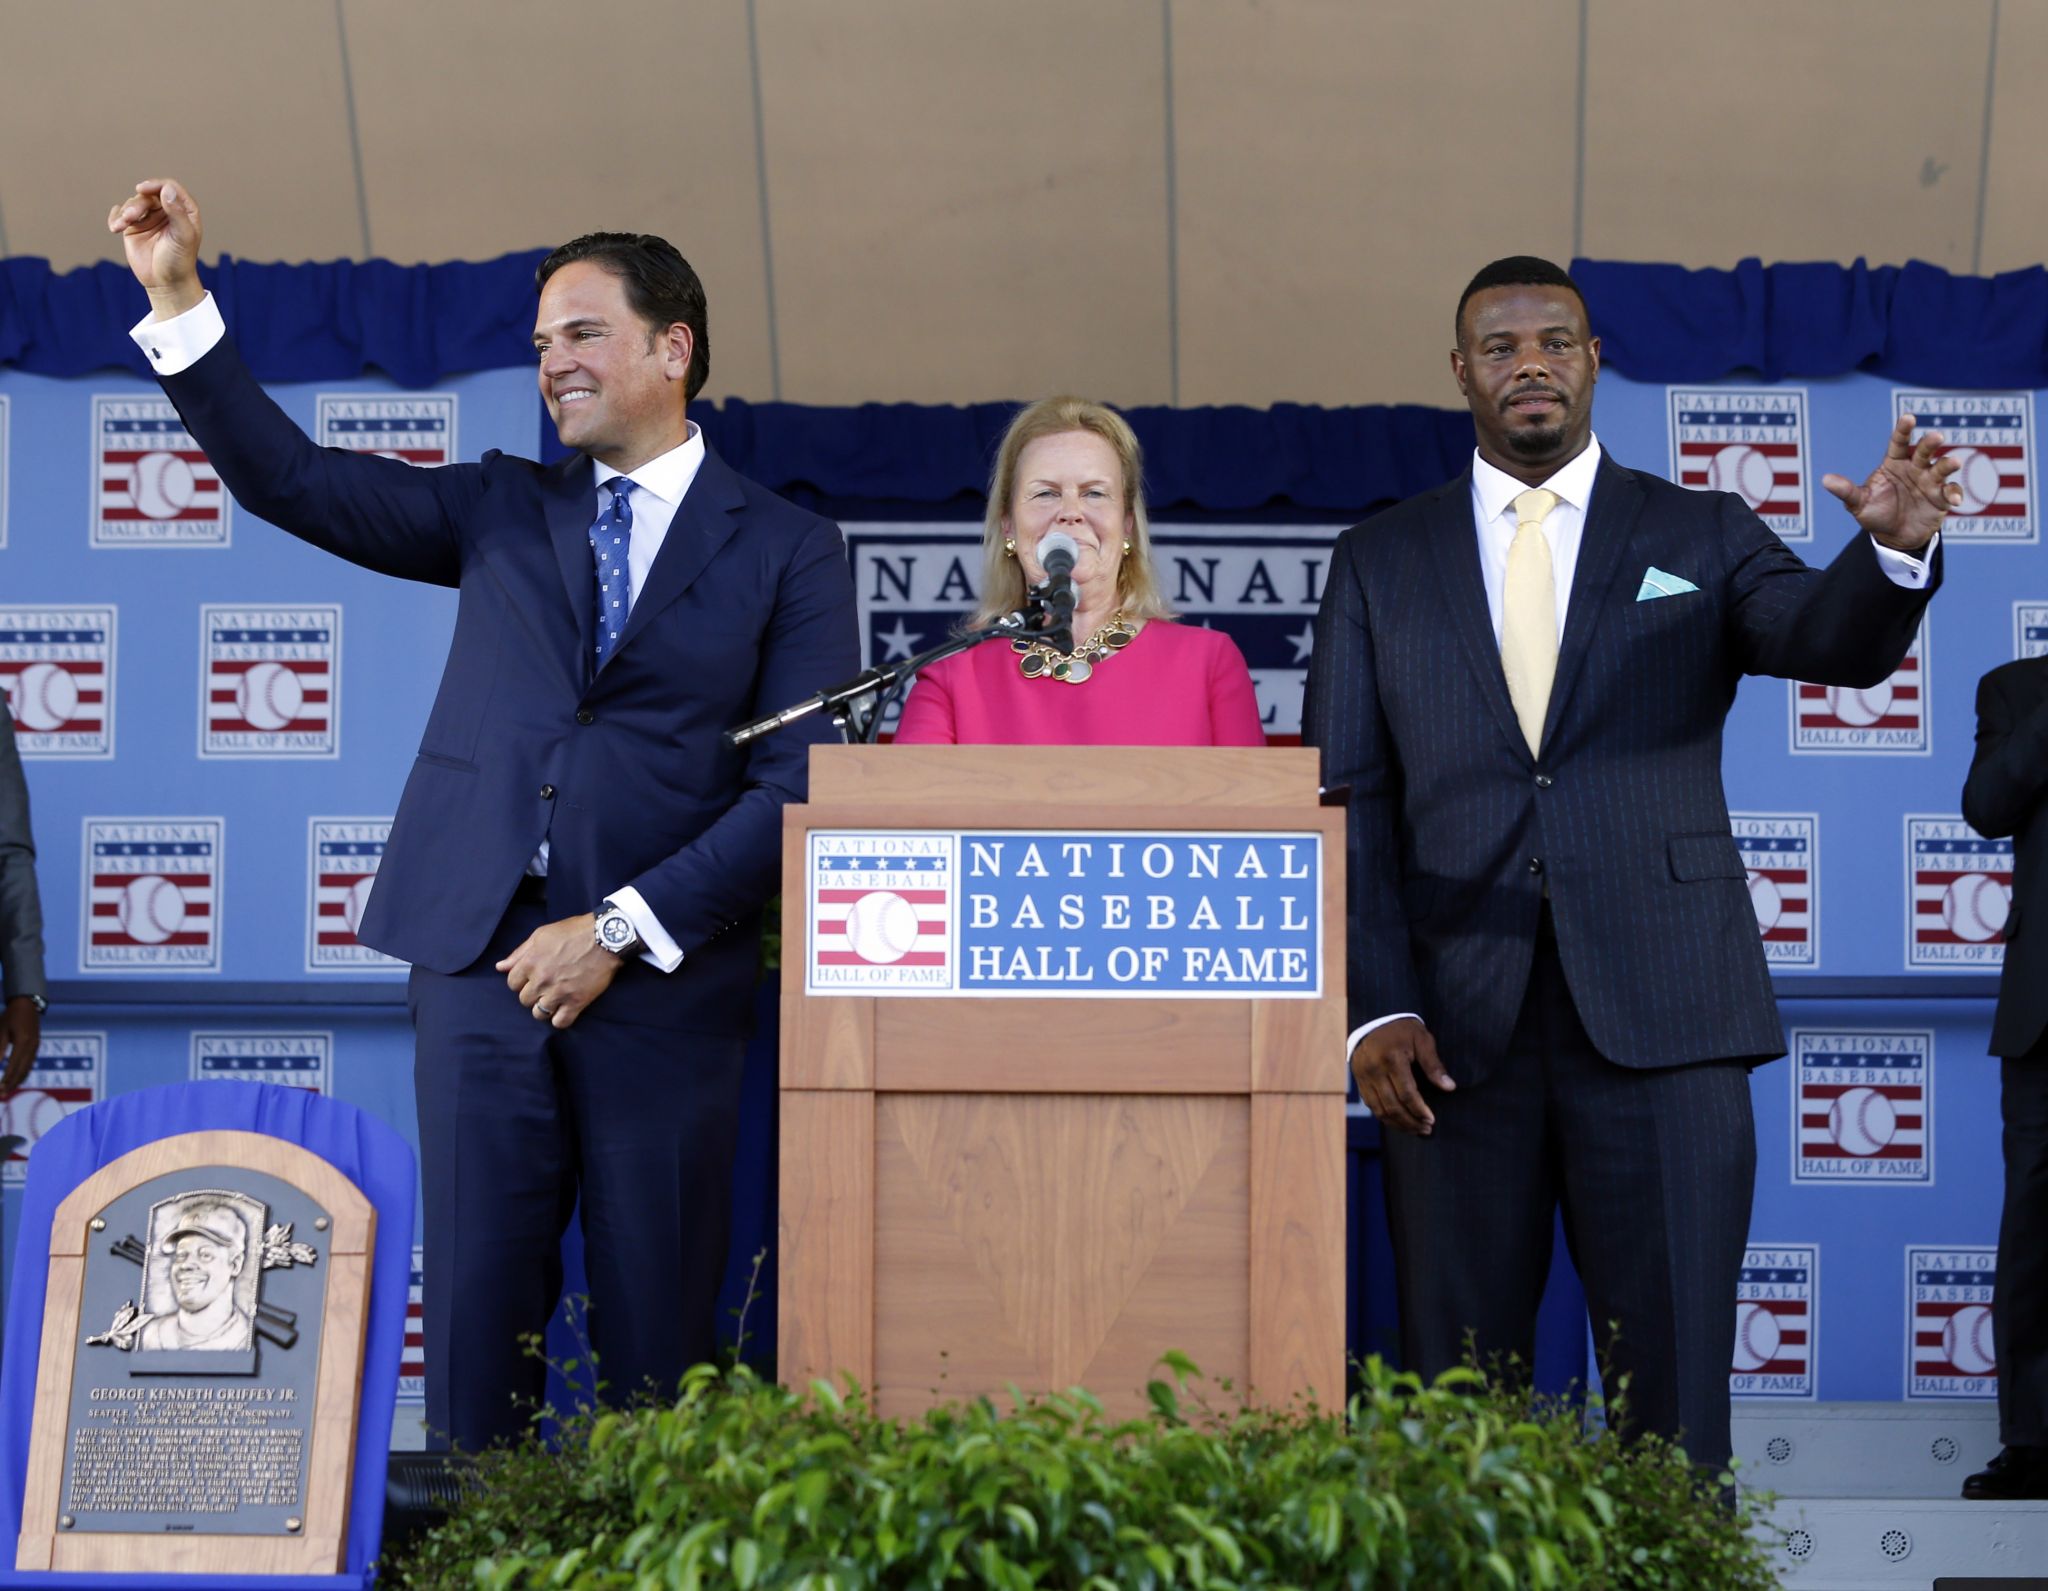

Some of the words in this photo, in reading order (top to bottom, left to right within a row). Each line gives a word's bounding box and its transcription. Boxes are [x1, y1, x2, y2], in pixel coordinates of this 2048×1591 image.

[329, 404, 444, 416] NATIONAL
[1679, 397, 1797, 410] NATIONAL
[1903, 401, 2022, 413] NATIONAL
[104, 406, 176, 418] NATIO
[328, 434, 444, 446] BASEBALL
[1680, 428, 1797, 441] BASEBALL
[104, 437, 191, 448] BASEBA
[102, 524, 143, 536] HALL
[149, 524, 167, 535] OF
[177, 524, 219, 536] FAME
[1765, 517, 1801, 530] AME
[1956, 519, 1977, 531] OF
[1984, 519, 2027, 532] FAME
[870, 556, 1324, 602] NANAL
[5, 616, 105, 628] ATIONAL
[213, 615, 329, 627] NATIONAL
[4, 647, 105, 659] ASEBALL
[212, 646, 329, 658] BASEBALL
[31, 735, 50, 747] OF
[60, 735, 102, 748] FAME
[210, 735, 252, 747] HALL
[256, 735, 276, 746] OF
[284, 735, 327, 747] FAME
[1800, 730, 1844, 744] HALL
[1849, 731, 1869, 744] OF
[1876, 731, 1920, 744] FAME
[94, 828, 212, 840] NATIONAL
[319, 827, 390, 840] NATIO
[1737, 822, 1808, 836] IONAL
[1916, 825, 1970, 838] NATI
[818, 840, 947, 853] NATIONAL
[94, 859, 212, 871] BASEBALL
[319, 859, 376, 871] BASE
[969, 843, 1309, 879] NATIONAL
[1751, 853, 1808, 867] BALL
[1916, 856, 2013, 869] BASEBA
[818, 874, 947, 886] BASEBALL
[969, 894, 1309, 930] BASEBALL
[91, 949, 134, 961] HALL
[138, 949, 158, 961] OF
[168, 949, 211, 961] FAME
[317, 949, 360, 961] HALL
[1765, 944, 1808, 957] FAME
[1916, 946, 1960, 959] HALL
[1964, 946, 1984, 959] OF
[969, 946, 1093, 981] HALL
[1107, 946, 1169, 982] OF
[1182, 948, 1308, 982] FAME
[817, 969, 865, 981] HALL
[870, 969, 893, 981] OF
[900, 969, 946, 982] FAME
[202, 1041, 322, 1054] NATIONAL
[1802, 1038, 1923, 1052] NATIONAL
[1802, 1069, 1923, 1083] BASEBALL
[1802, 1160, 1846, 1173] HALL
[1851, 1160, 1872, 1173] OF
[1879, 1161, 1923, 1174] FAME
[1748, 1254, 1808, 1267] ONAL
[1916, 1256, 1989, 1268] NATIO
[1737, 1285, 1808, 1298] EBALL
[1916, 1287, 1990, 1300] BASEB
[1734, 1376, 1756, 1389] OF
[1761, 1377, 1807, 1390] FAME
[1915, 1379, 1958, 1391] HALL
[1963, 1379, 1985, 1392] OF
[90, 1388, 146, 1401] GEORGE
[150, 1388, 213, 1401] KENNETH
[217, 1388, 275, 1401] GRIFFEY
[279, 1388, 298, 1401] JR.
